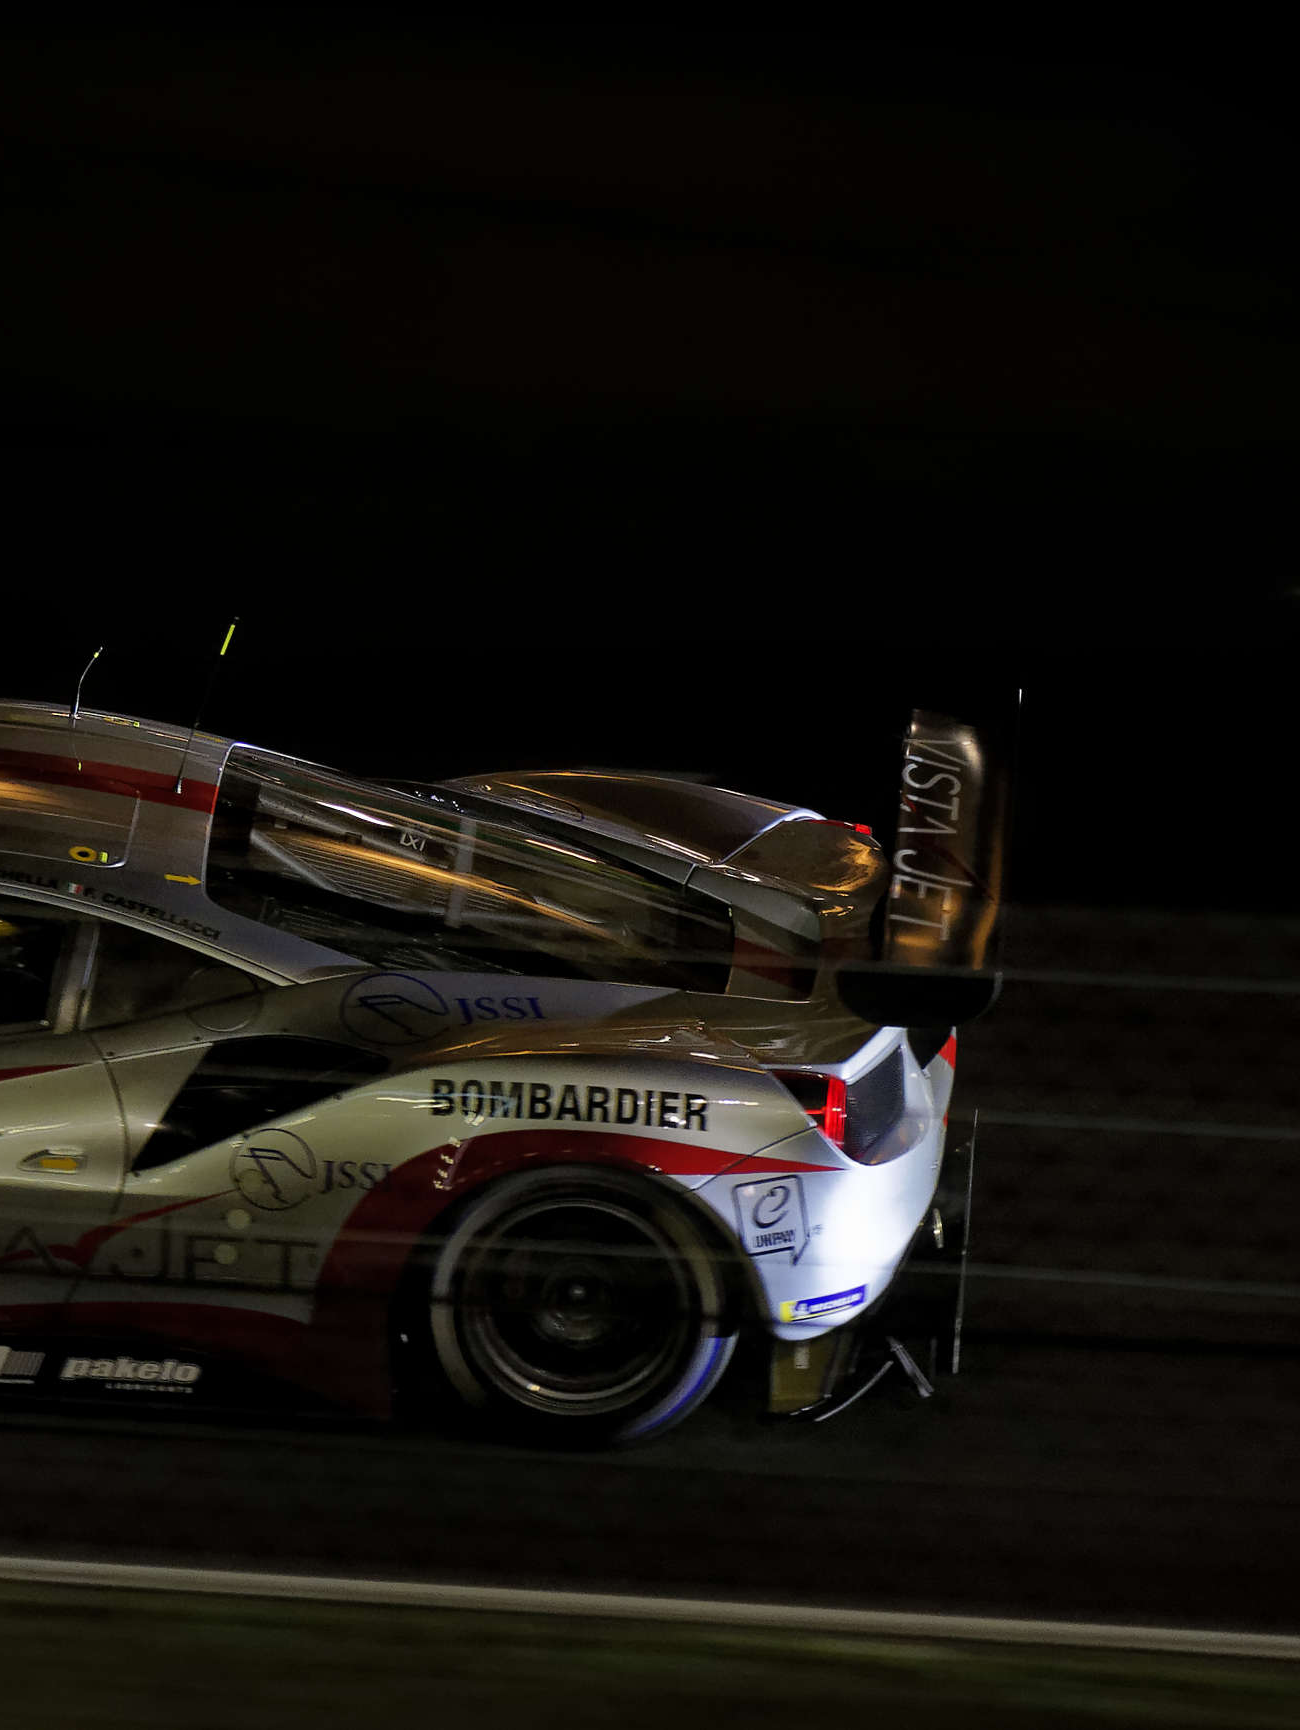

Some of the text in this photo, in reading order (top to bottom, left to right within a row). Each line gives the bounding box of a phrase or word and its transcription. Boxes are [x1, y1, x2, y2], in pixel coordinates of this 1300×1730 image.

[888, 737, 975, 942] VISTA JET
[454, 996, 546, 1026] JSSI
[430, 1078, 708, 1132] BOMBARDIER
[58, 1354, 203, 1383] pakelo
